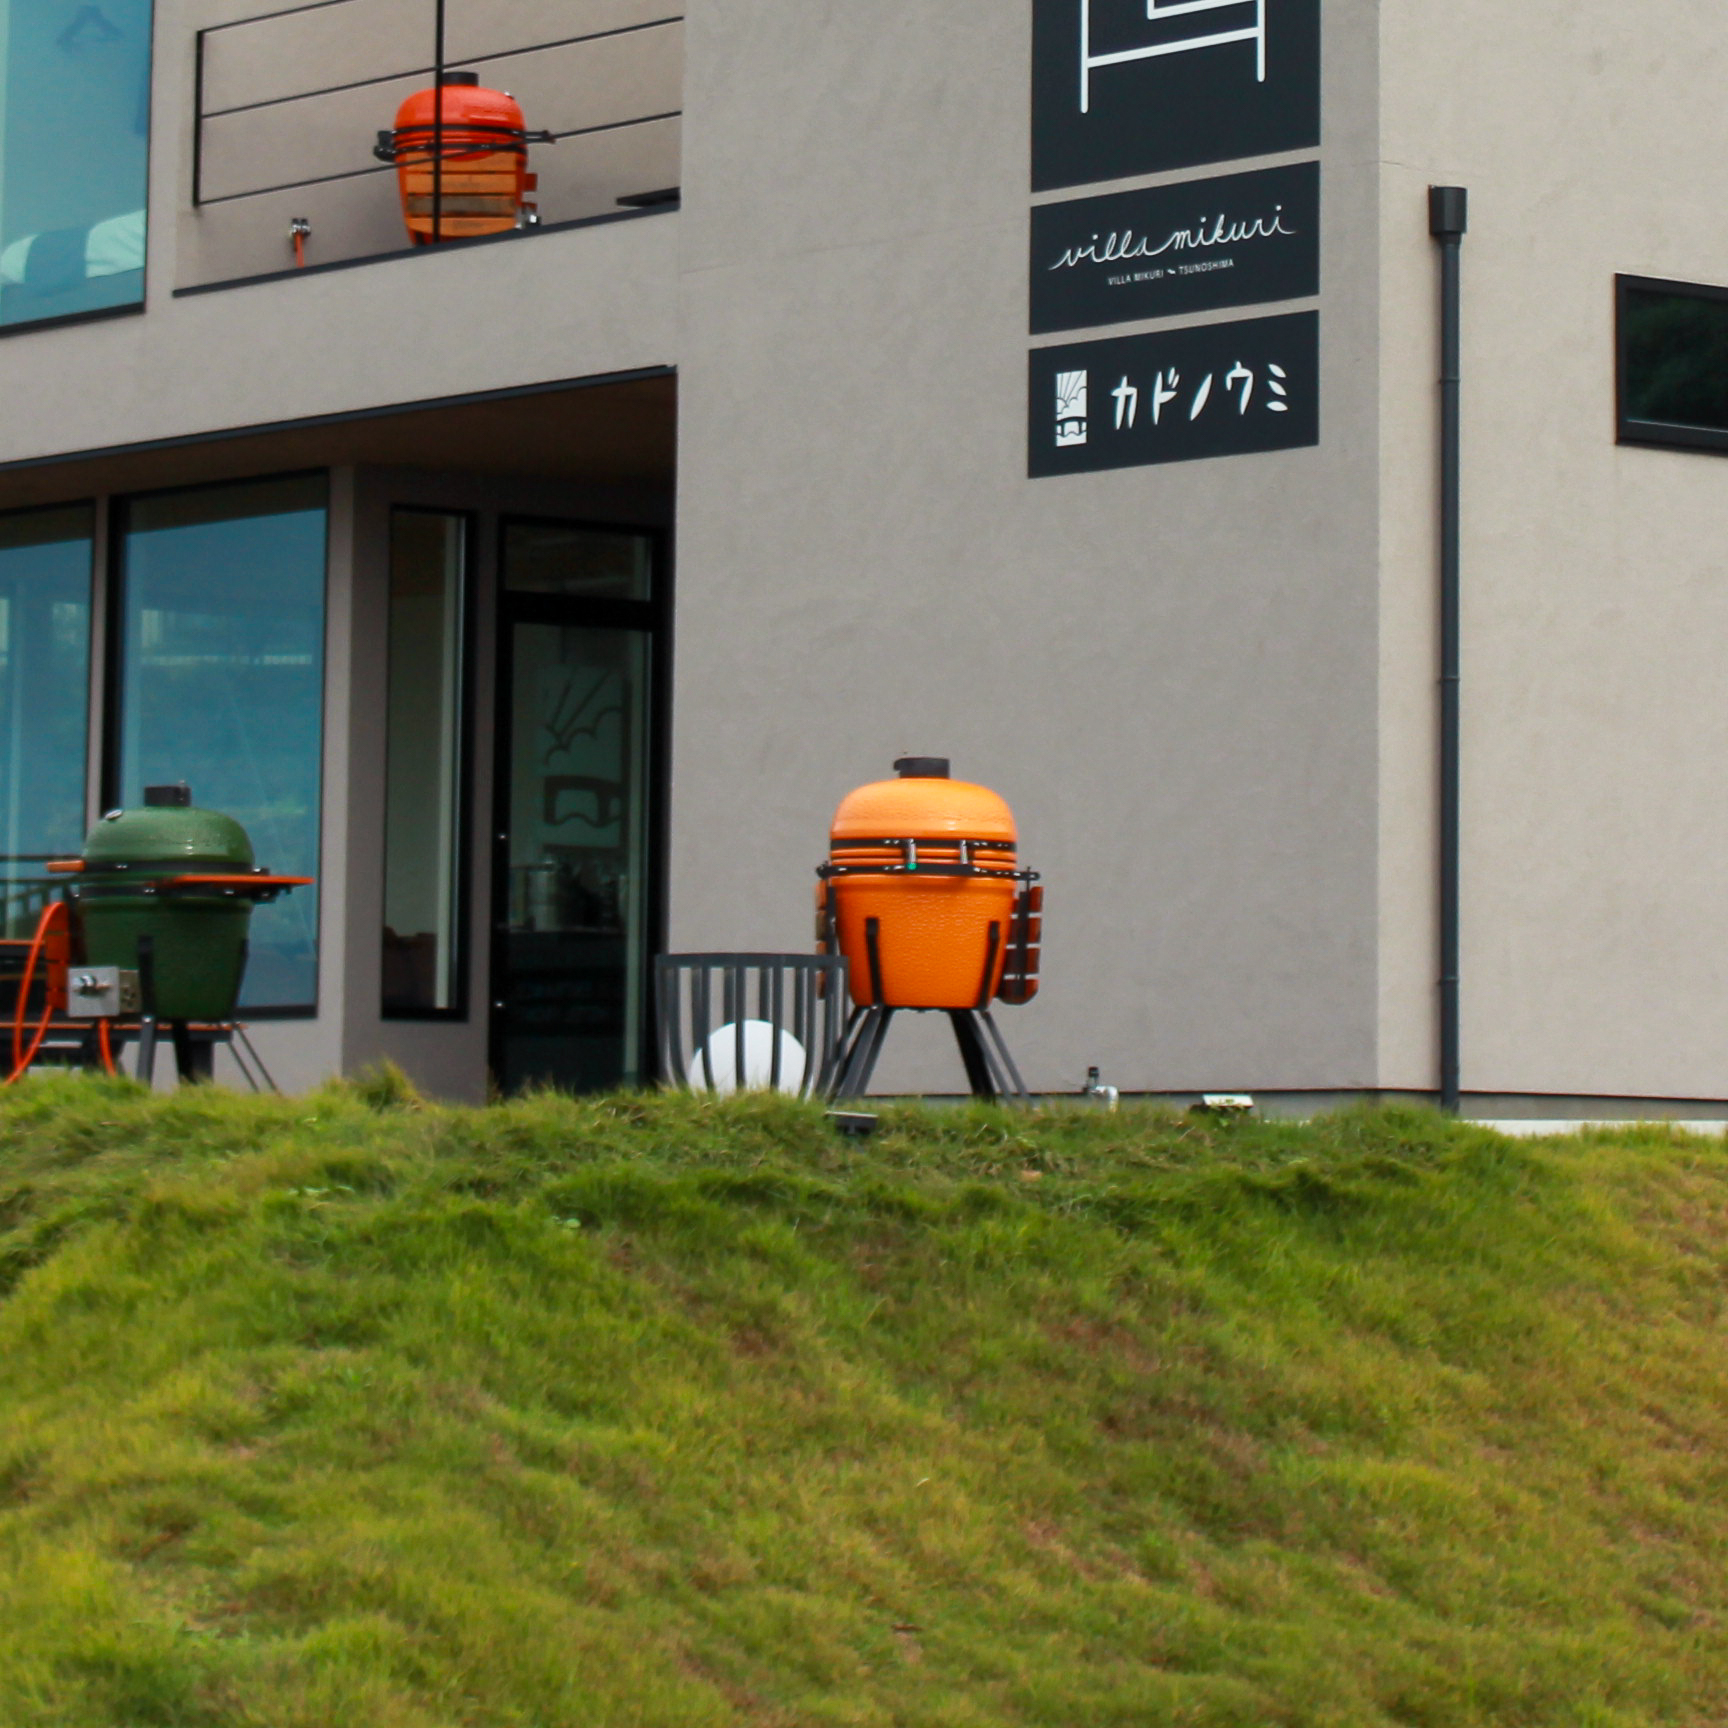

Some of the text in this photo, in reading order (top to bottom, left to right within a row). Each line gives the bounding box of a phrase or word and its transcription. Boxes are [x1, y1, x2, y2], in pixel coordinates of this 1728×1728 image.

[1048, 204, 1298, 270] villa mikuri
[1108, 258, 1234, 286] VILLA MIKURI TSUNOSHIMA
[1110, 360, 1288, 431] カドノウミ
